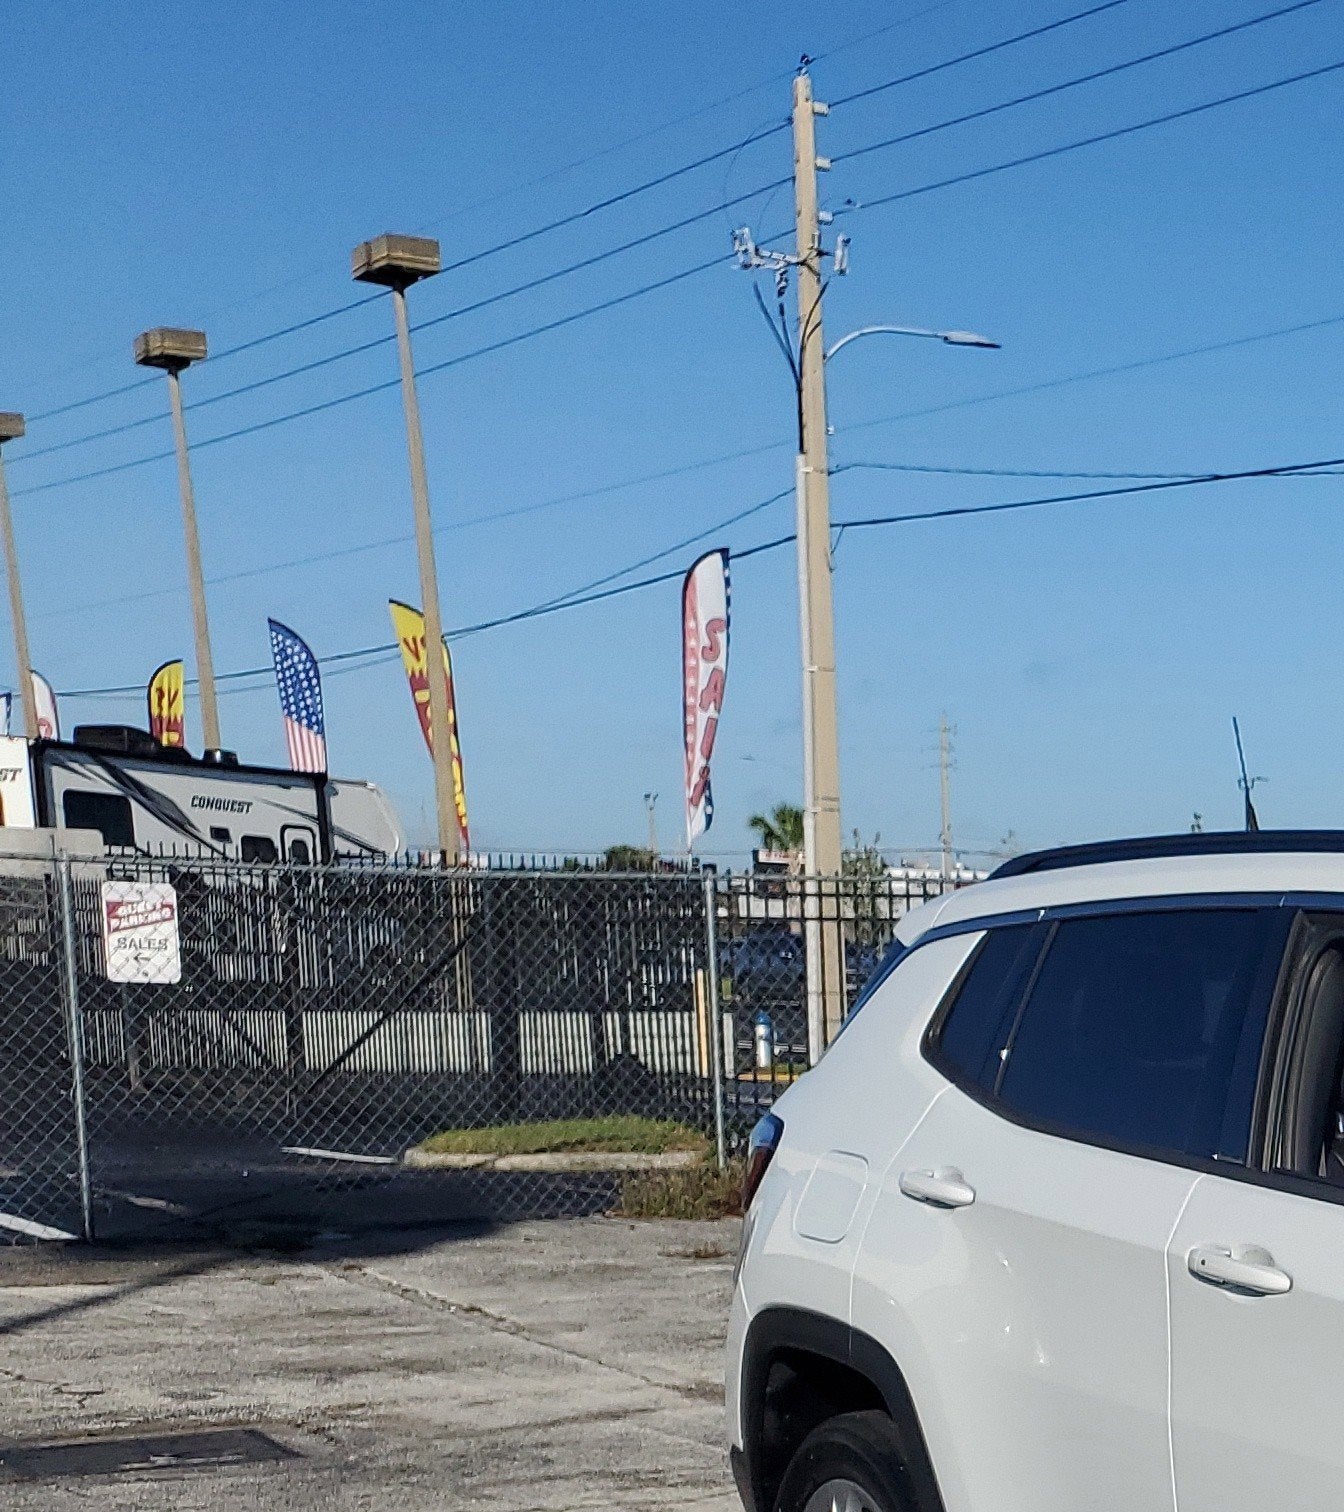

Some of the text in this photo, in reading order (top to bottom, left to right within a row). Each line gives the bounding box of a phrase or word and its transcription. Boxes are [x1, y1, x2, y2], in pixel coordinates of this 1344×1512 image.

[190, 794, 254, 815] CONQUEST
[110, 908, 172, 932] PARKING
[117, 937, 169, 950] SALES
